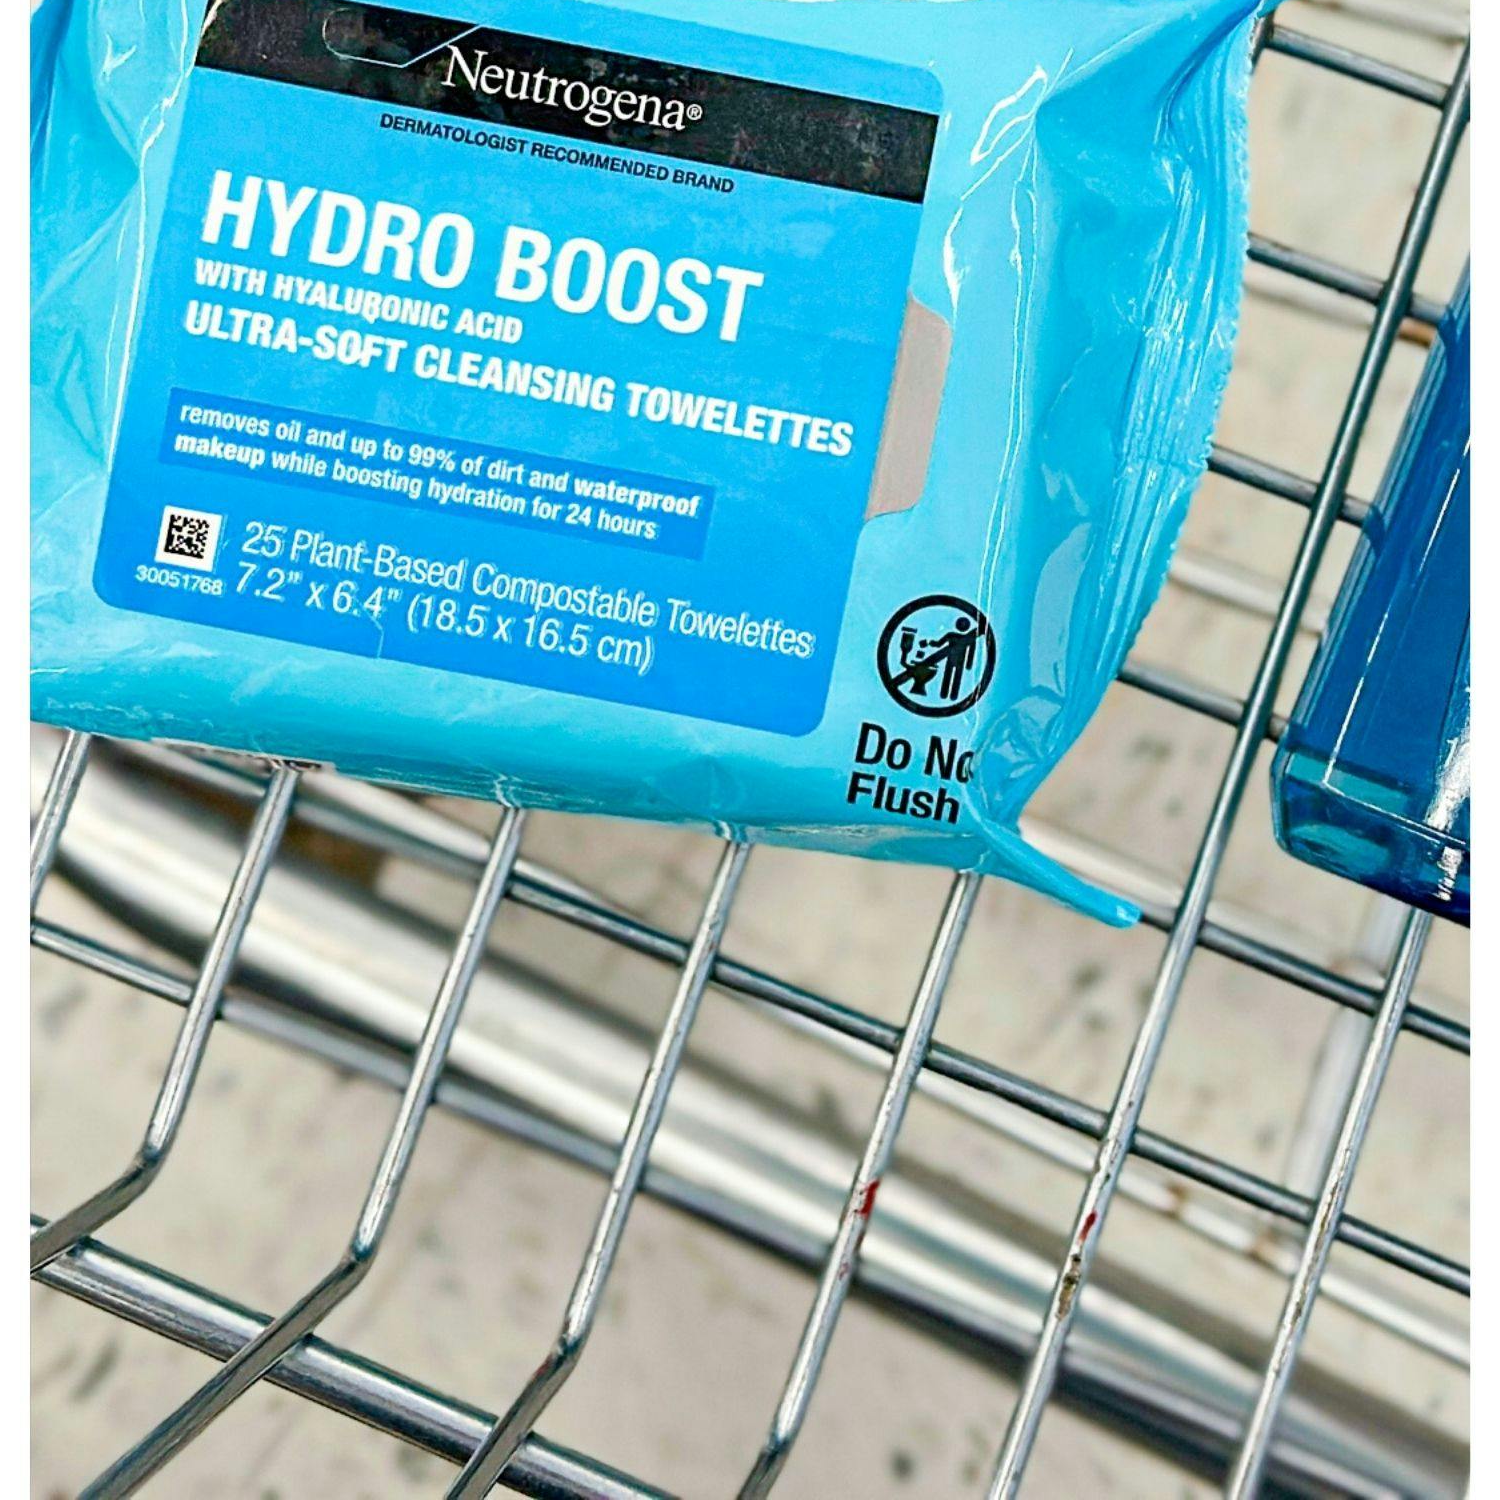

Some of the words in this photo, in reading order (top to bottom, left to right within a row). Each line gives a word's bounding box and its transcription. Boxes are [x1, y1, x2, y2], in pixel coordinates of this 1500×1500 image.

[380, 113, 528, 155] DERMATOLOGIST
[531, 139, 671, 179] RECOMMENDED
[672, 166, 734, 194] BRAND
[200, 170, 474, 289] HYDRO
[496, 224, 764, 342] BOOST
[196, 258, 265, 295] WITH
[455, 311, 522, 345] ACID
[186, 301, 400, 374] ULTRA-SOFT
[414, 346, 614, 413] CLEANSING
[626, 382, 854, 457] TOWELETTES
[175, 431, 265, 468] makeup
[333, 458, 422, 500] boosting
[428, 478, 526, 517] hydration
[565, 504, 593, 526] 24
[598, 510, 656, 539] hours
[180, 403, 270, 437] removes
[408, 445, 456, 473] 99%
[487, 455, 526, 484] dirt
[574, 473, 700, 519] waterproof
[136, 566, 222, 596] 30051768
[241, 522, 285, 557] 25
[290, 529, 465, 592] Plant-Based
[472, 562, 660, 627] Compostable
[667, 599, 814, 658] Towelettes
[407, 593, 486, 637] (18.5
[523, 615, 590, 657] 16.5
[855, 722, 911, 770] Do
[848, 772, 960, 824] Flush
